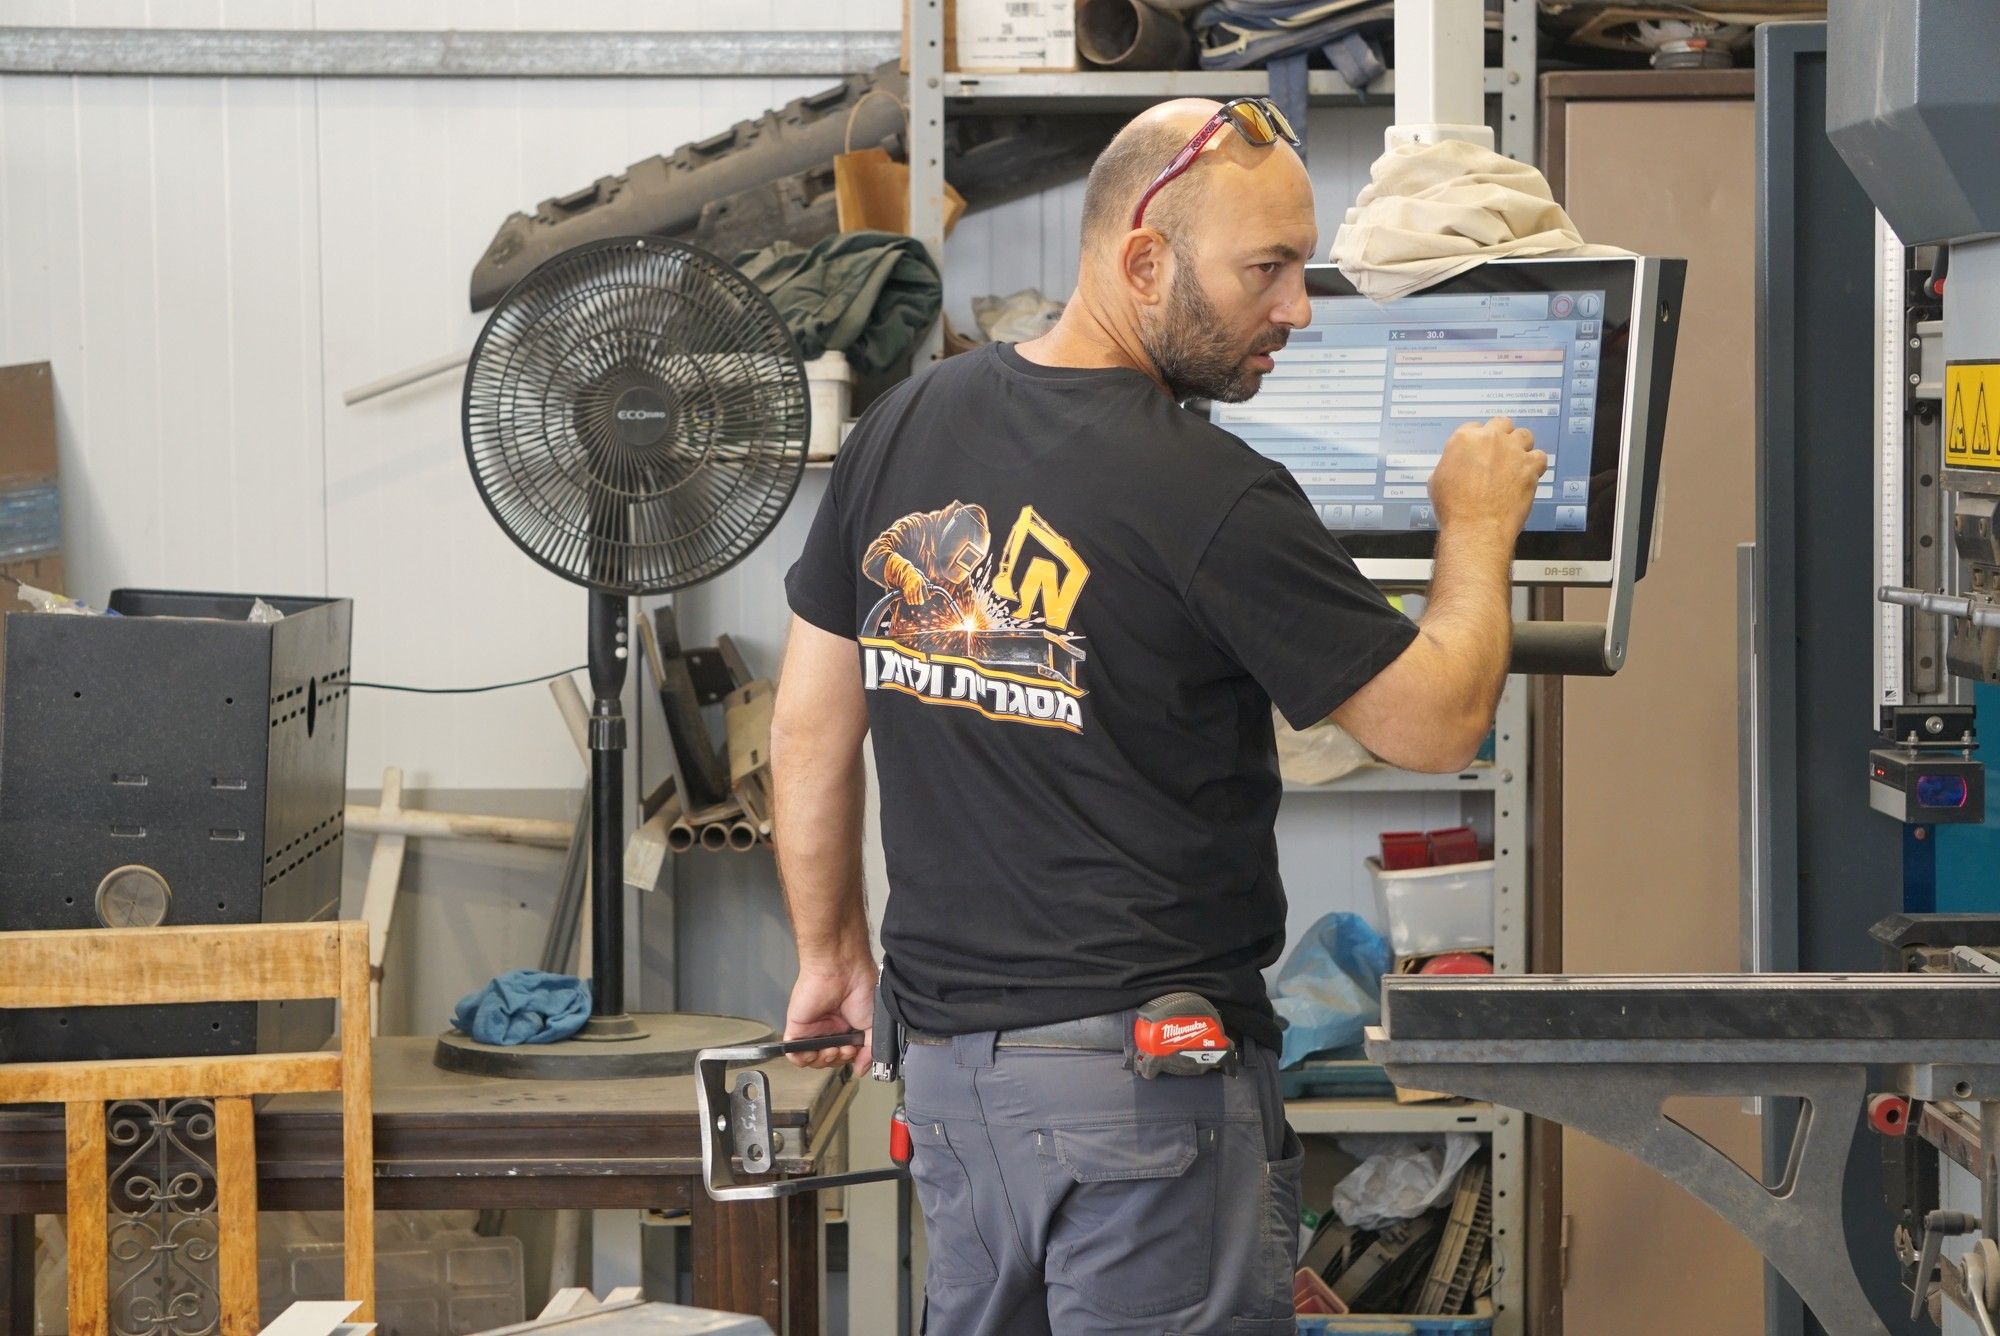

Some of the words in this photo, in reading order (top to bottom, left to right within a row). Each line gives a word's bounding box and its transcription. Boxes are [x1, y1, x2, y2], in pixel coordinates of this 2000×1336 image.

[1391, 331, 1398, 339] X
[1426, 331, 1445, 339] 30.0
[1544, 566, 1583, 576] DA-58T
[1161, 1020, 1208, 1040] Milwaukee
[1202, 1039, 1216, 1047] 5m
